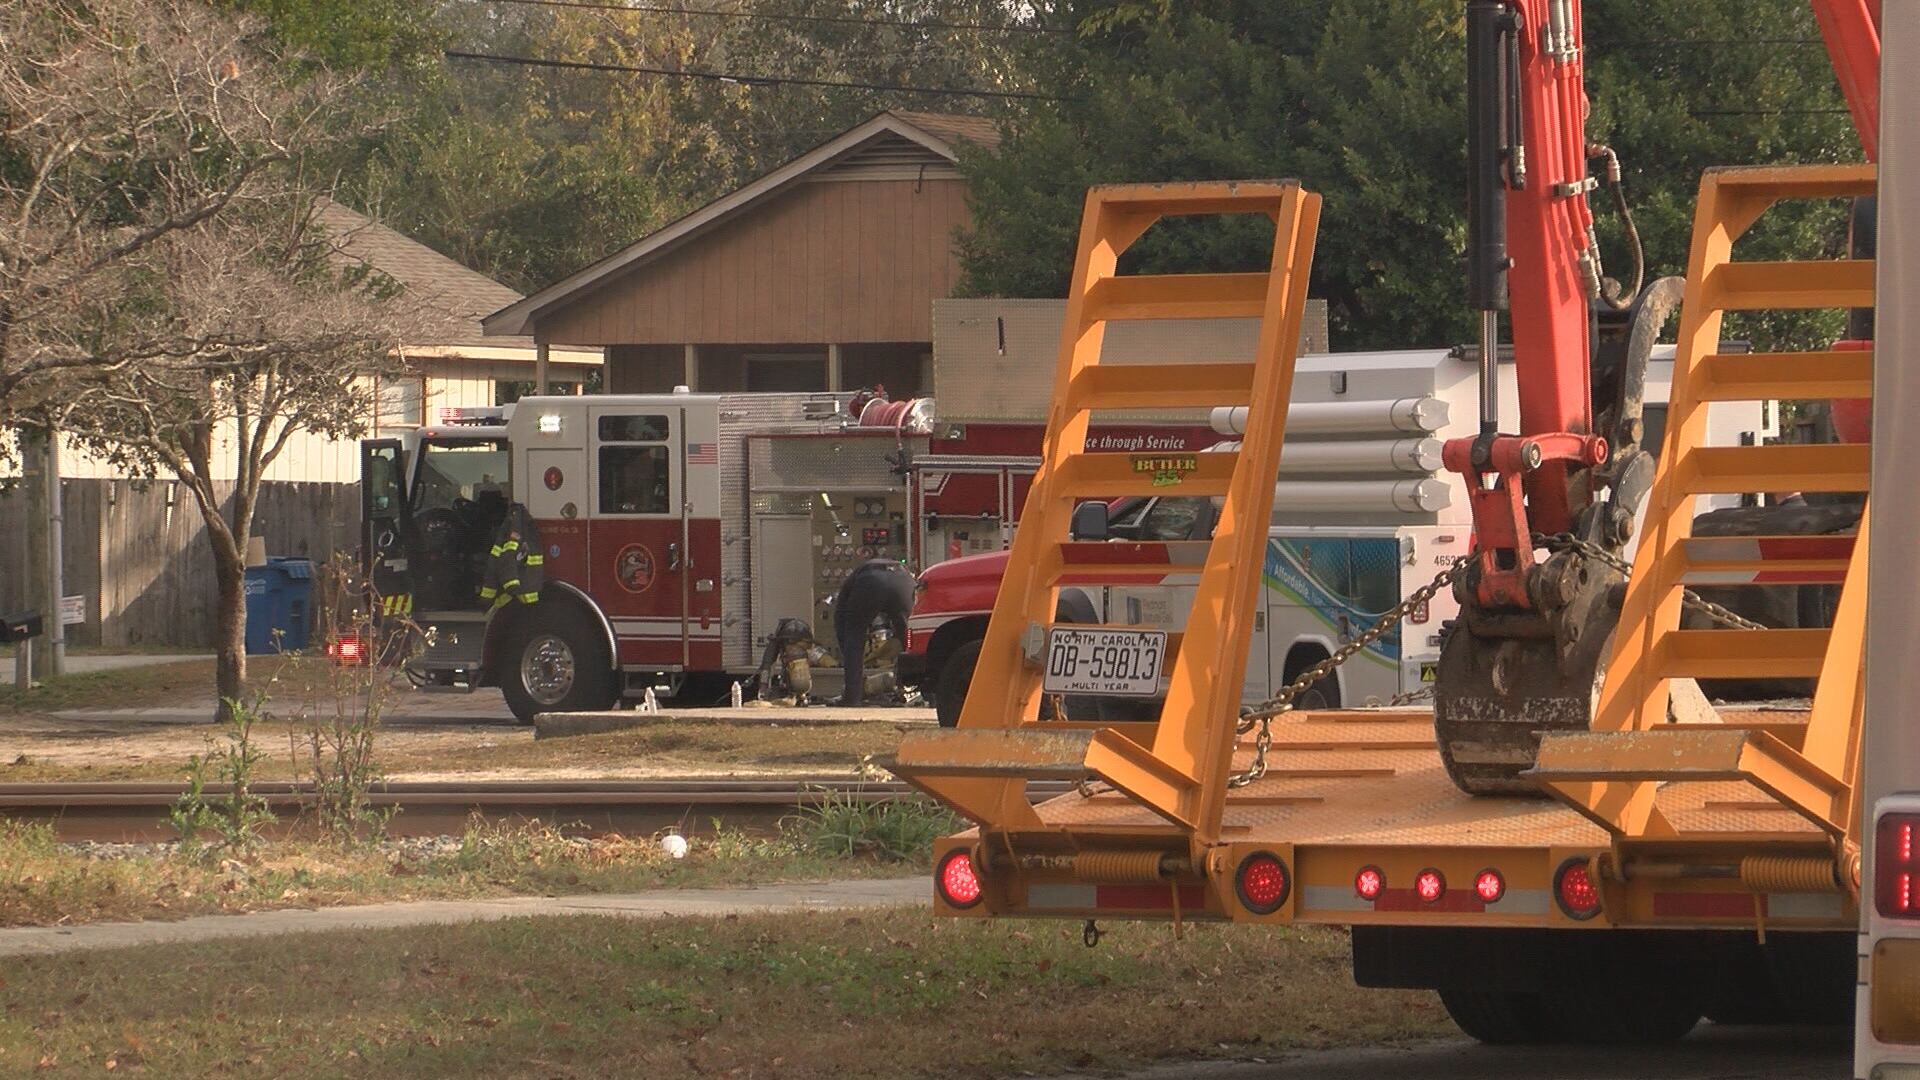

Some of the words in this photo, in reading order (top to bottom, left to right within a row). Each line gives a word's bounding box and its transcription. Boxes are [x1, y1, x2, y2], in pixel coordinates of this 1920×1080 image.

[1100, 435, 1144, 451] through
[1146, 435, 1185, 449] Service
[1136, 459, 1196, 471] BUTLER
[1054, 634, 1096, 645] NORTH
[1101, 635, 1159, 647] CAROLINA
[1050, 644, 1158, 680] DB-59813
[1071, 682, 1099, 690] MULTI
[1104, 682, 1129, 691] YEAR
